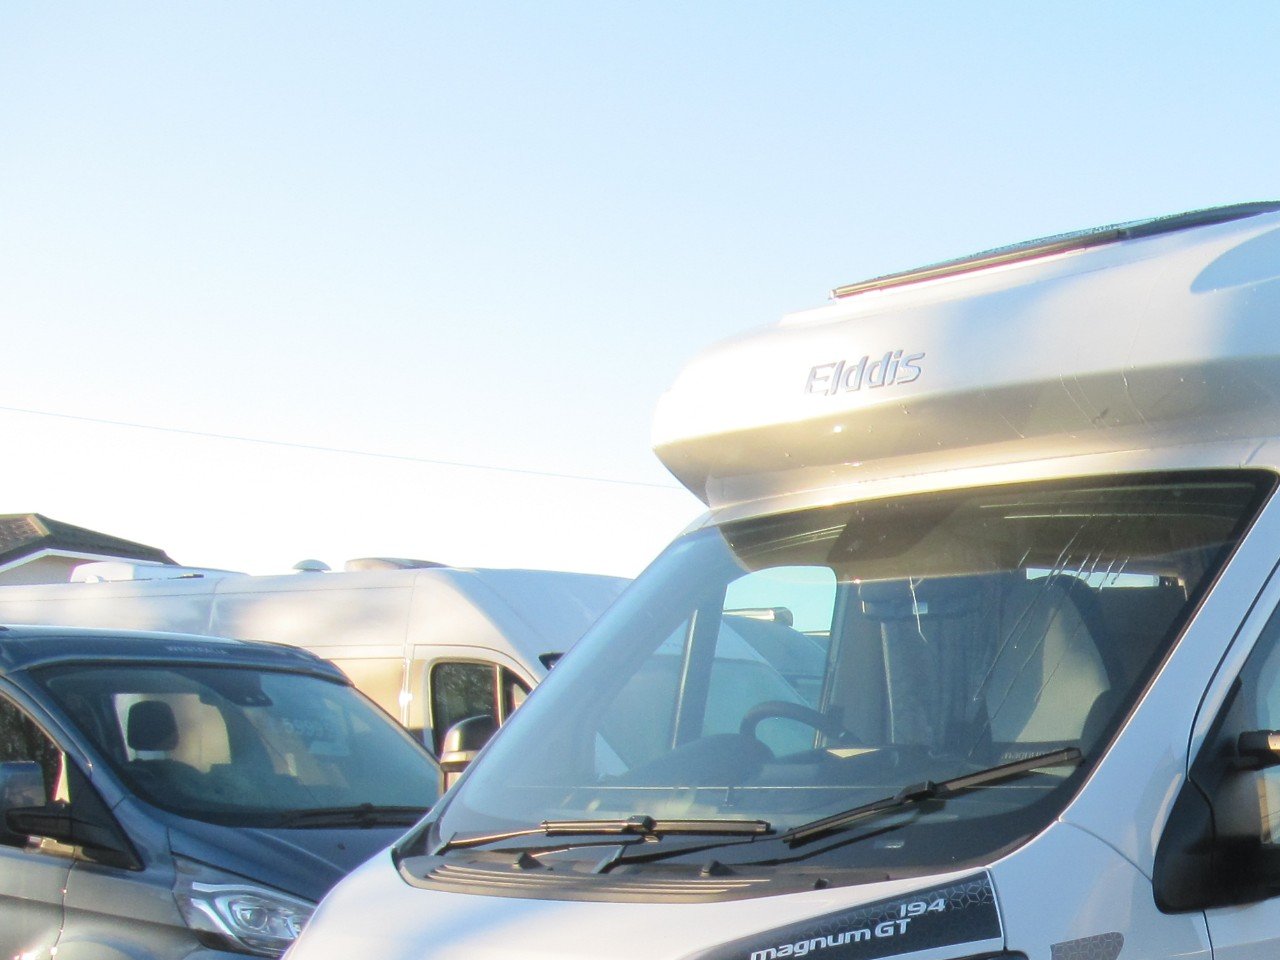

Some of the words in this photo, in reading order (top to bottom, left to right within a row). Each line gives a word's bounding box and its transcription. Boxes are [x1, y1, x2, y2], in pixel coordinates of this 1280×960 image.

[804, 349, 926, 397] Elddis
[899, 898, 946, 918] 194
[874, 917, 912, 938] GT
